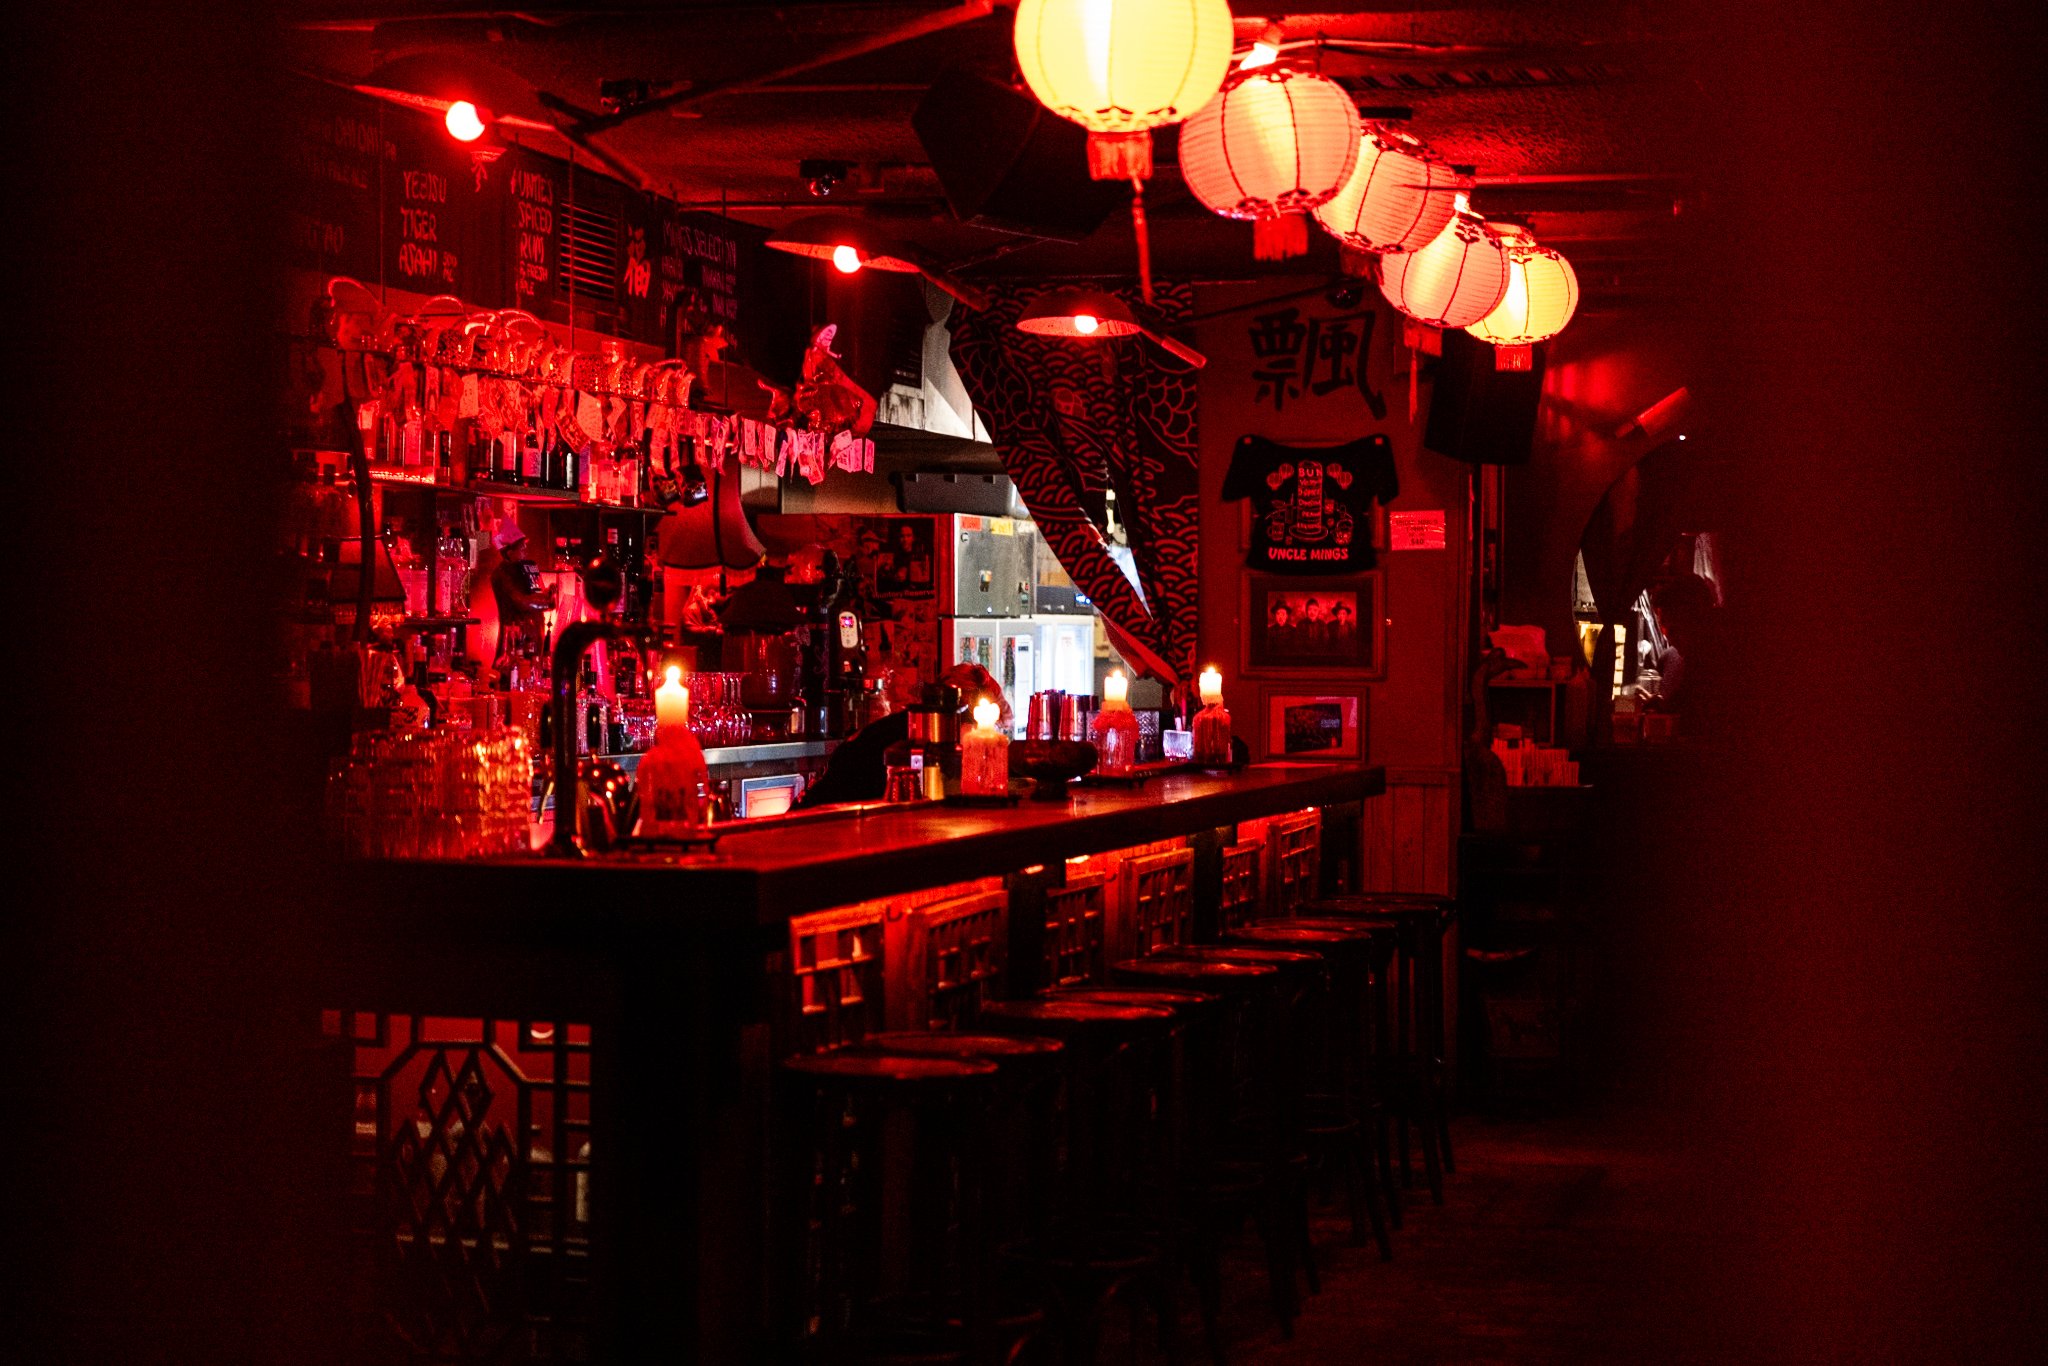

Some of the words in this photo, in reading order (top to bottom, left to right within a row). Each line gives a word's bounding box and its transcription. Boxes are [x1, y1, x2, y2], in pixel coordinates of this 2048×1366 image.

[400, 206, 437, 243] TIGER
[518, 201, 552, 235] SPICED
[398, 242, 438, 277] ASAHI
[519, 231, 545, 263] RUM
[1267, 547, 1307, 561] UNCLE
[1310, 547, 1350, 561] MINGS
